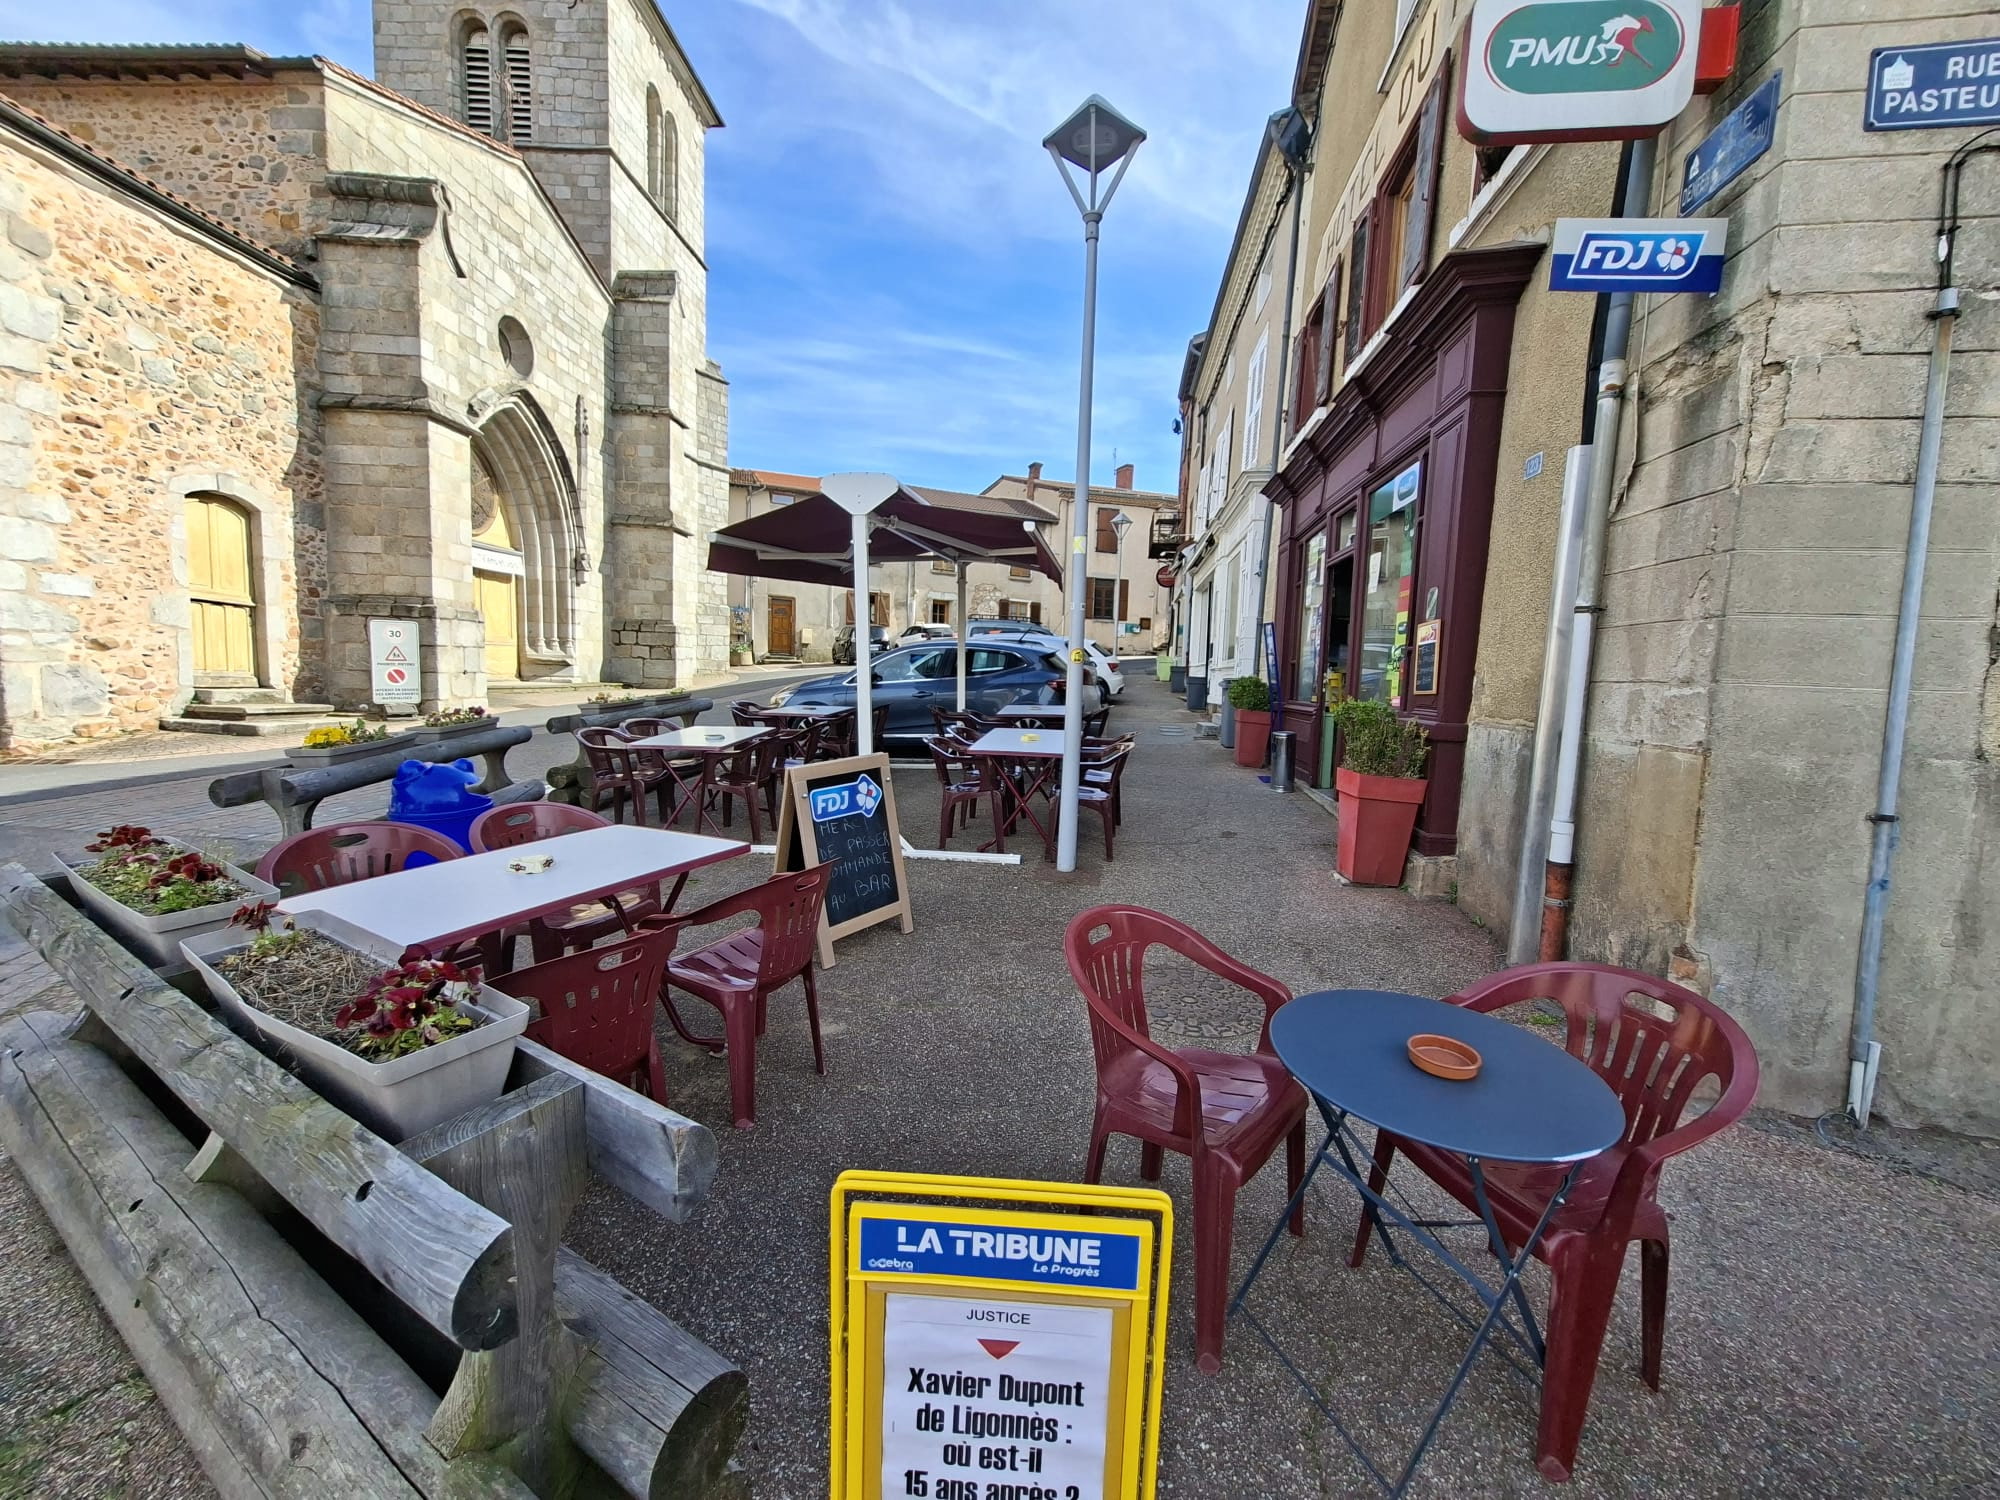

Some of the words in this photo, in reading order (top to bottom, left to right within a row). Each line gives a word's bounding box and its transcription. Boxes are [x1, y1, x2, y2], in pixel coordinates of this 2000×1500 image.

[1505, 35, 1598, 69] PMU
[1945, 52, 2000, 80] RUE
[1580, 240, 1654, 270] FDJ
[388, 630, 402, 638] 30
[816, 790, 849, 815] FDJ
[847, 830, 890, 853] PASSER
[831, 851, 891, 878] OMMANDE
[831, 893, 847, 910] AU
[854, 874, 892, 897] BAR
[897, 1226, 943, 1254] LA
[949, 1229, 1101, 1266] TRIBUNE
[1033, 1262, 1049, 1273] Le
[1051, 1264, 1100, 1278] Progrès
[966, 1308, 1031, 1325] JUSTICE
[907, 1367, 992, 1398] Xavier
[999, 1374, 1085, 1407] Dupont
[916, 1402, 945, 1432] de
[952, 1404, 1059, 1443] Ligonnès
[943, 1441, 972, 1467] où
[979, 1444, 1043, 1473] est-il
[904, 1469, 929, 1498] 15
[935, 1477, 978, 1500] ans
